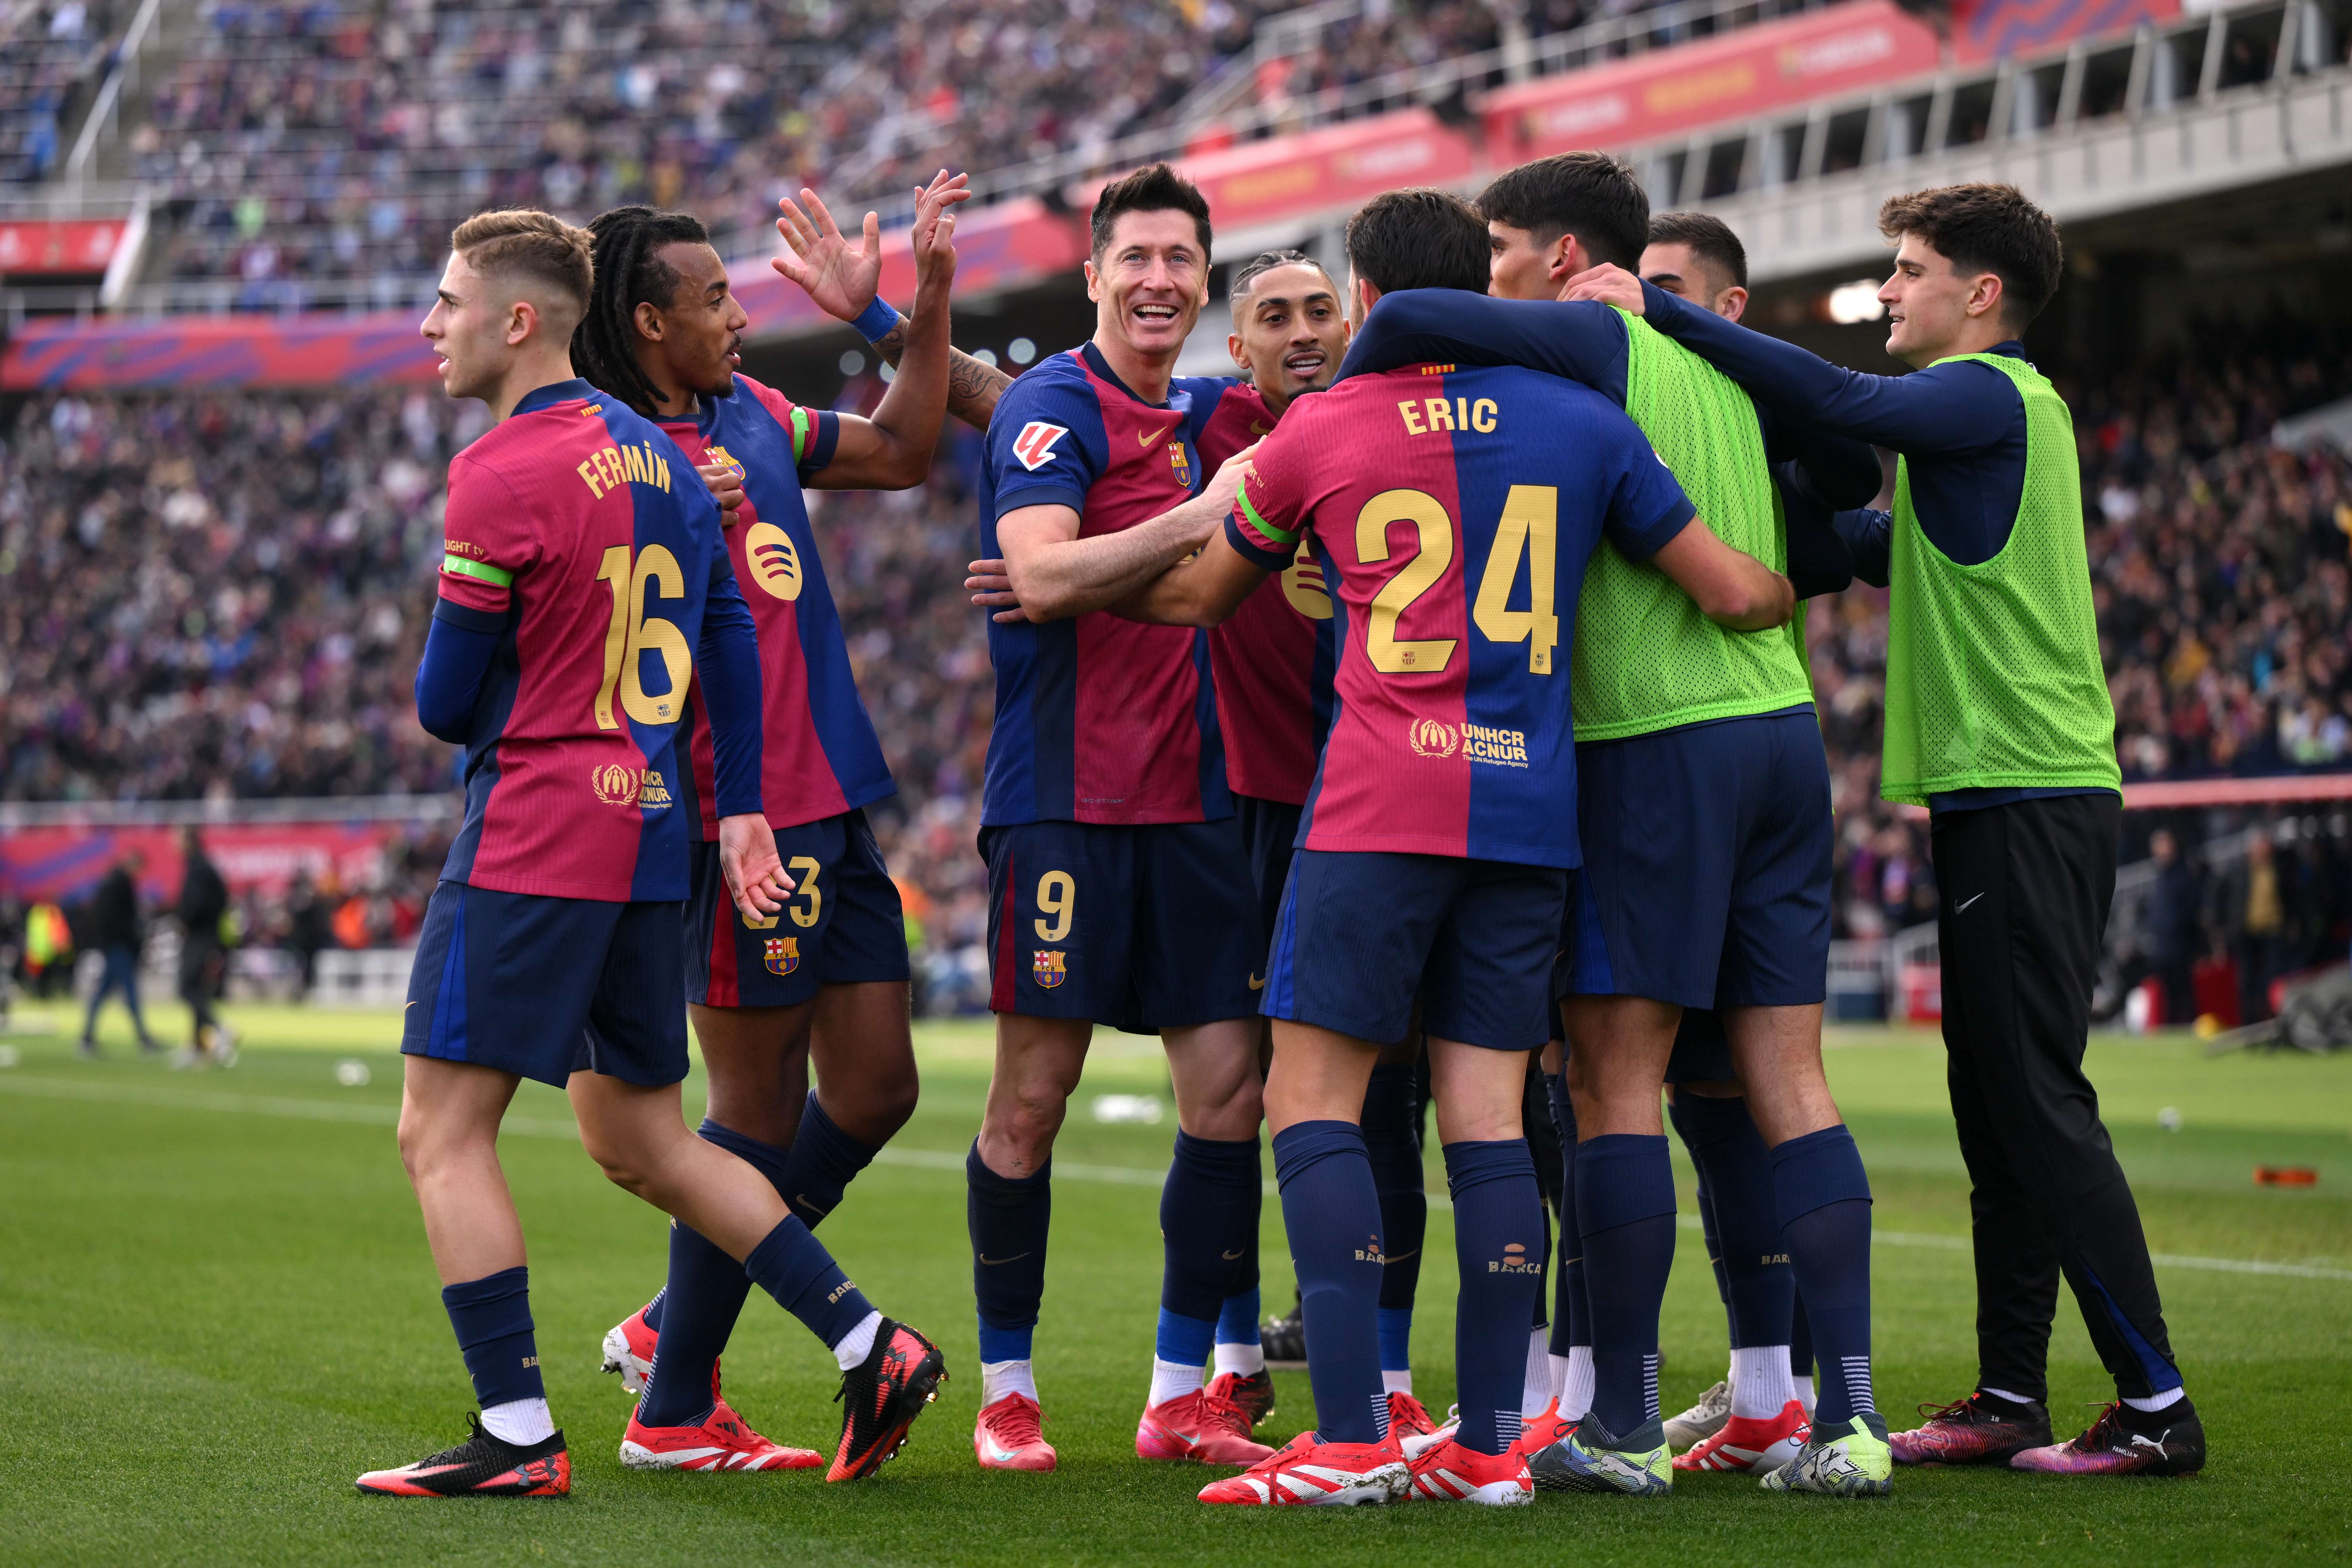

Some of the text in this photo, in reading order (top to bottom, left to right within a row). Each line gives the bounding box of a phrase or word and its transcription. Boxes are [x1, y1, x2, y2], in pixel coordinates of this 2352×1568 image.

[1397, 397, 1498, 435] ERIC
[473, 545, 485, 555] tv
[1355, 484, 1558, 675] 24
[594, 543, 692, 730] 16
[1460, 723, 1525, 747] UNHCR
[1461, 739, 1528, 761] ACNUR
[1034, 870, 1075, 942] 9
[2112, 1445, 2133, 1458] FAMILIA
